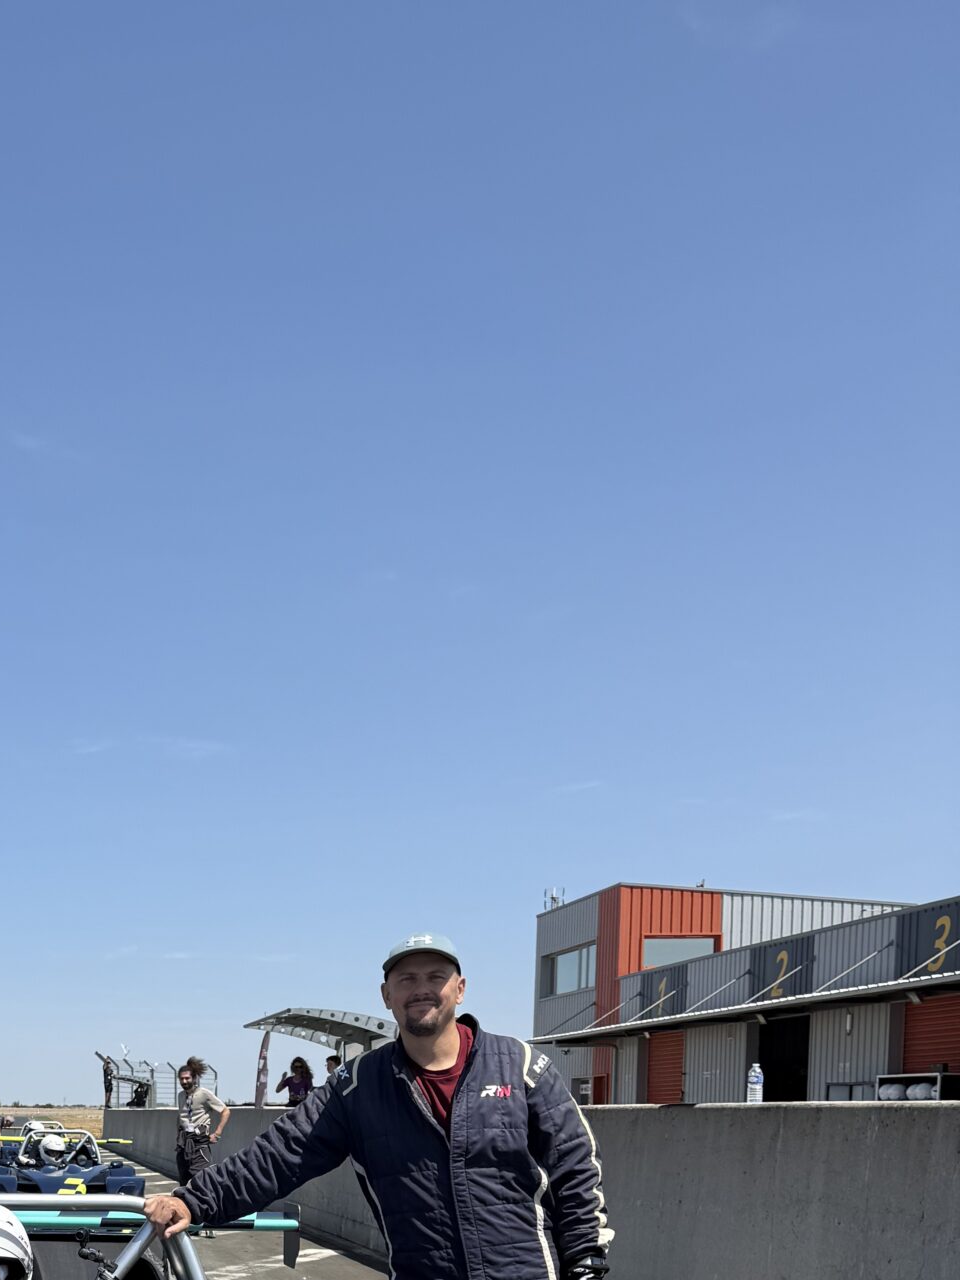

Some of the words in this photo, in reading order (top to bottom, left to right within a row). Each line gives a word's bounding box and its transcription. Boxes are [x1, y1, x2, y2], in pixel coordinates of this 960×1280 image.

[927, 915, 951, 972] 3
[657, 976, 667, 1016] 1
[770, 950, 788, 997] 2
